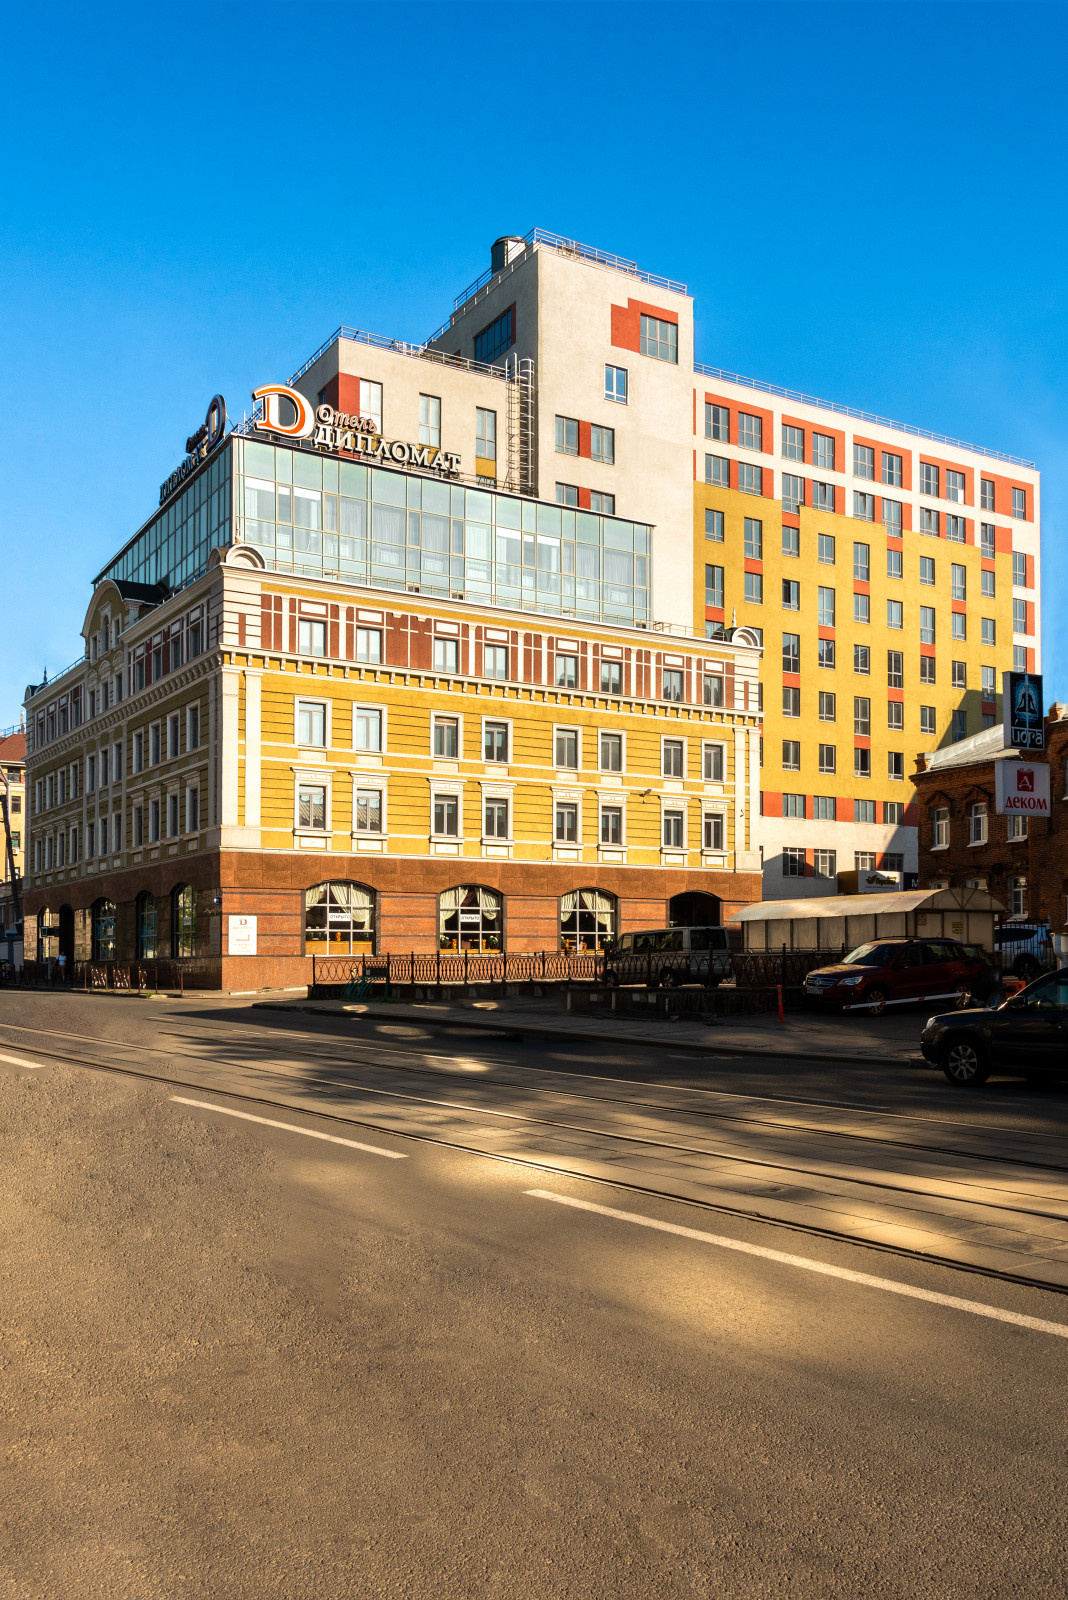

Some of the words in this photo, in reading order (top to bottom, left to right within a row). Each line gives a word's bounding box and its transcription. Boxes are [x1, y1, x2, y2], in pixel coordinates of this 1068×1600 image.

[252, 383, 315, 440] D
[317, 403, 378, 434] Отель
[312, 422, 462, 473] ДИПЛОМАТ
